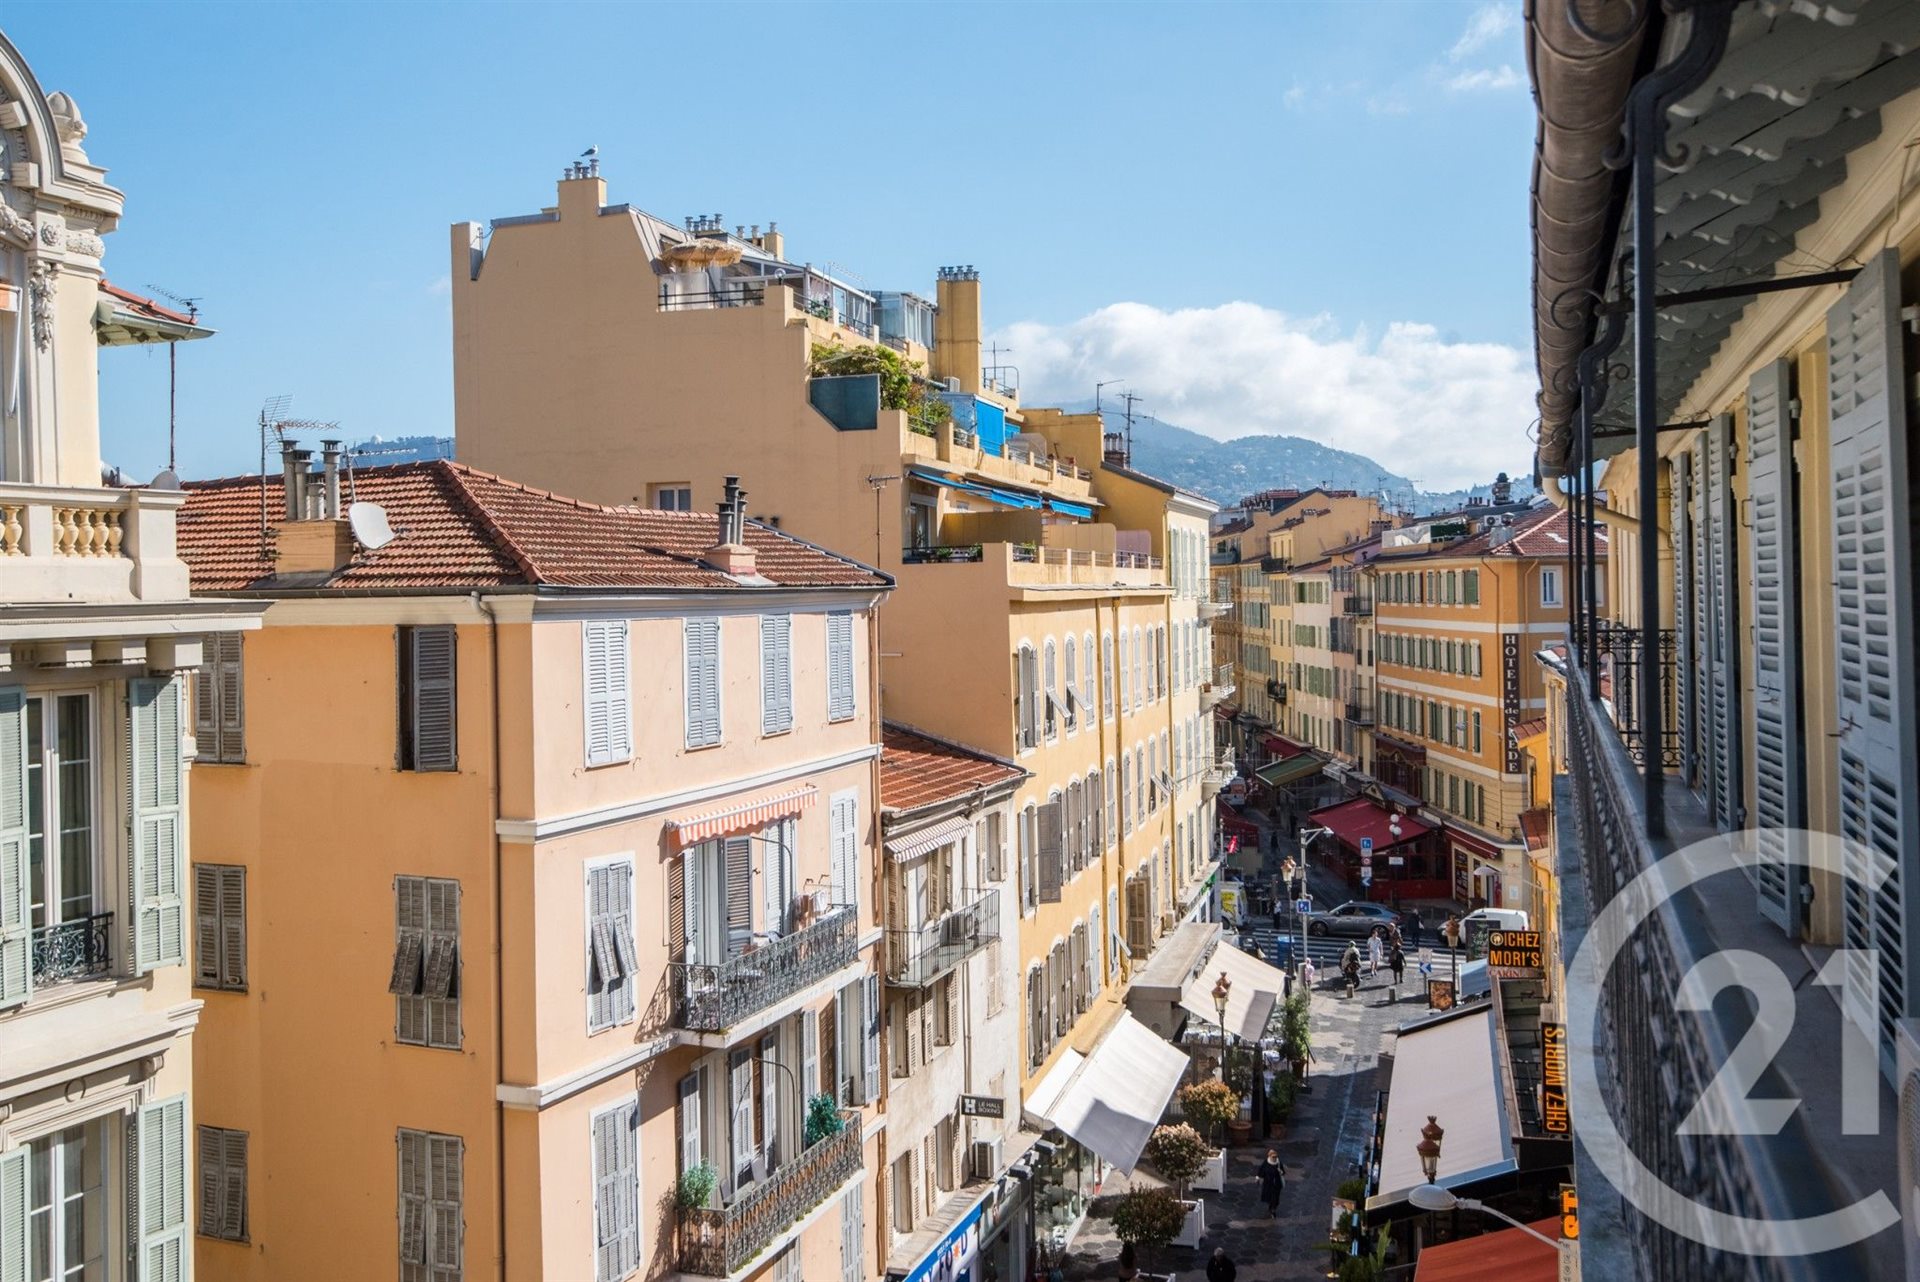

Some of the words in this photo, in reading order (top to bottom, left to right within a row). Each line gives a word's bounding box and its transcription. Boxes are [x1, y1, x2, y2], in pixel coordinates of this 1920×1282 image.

[1505, 635, 1517, 690] HOTEL
[1505, 707, 1519, 715] de
[1490, 950, 1540, 967] MORI'S
[1544, 1027, 1566, 1087] MORI'S
[1546, 1092, 1567, 1132] CHEZ
